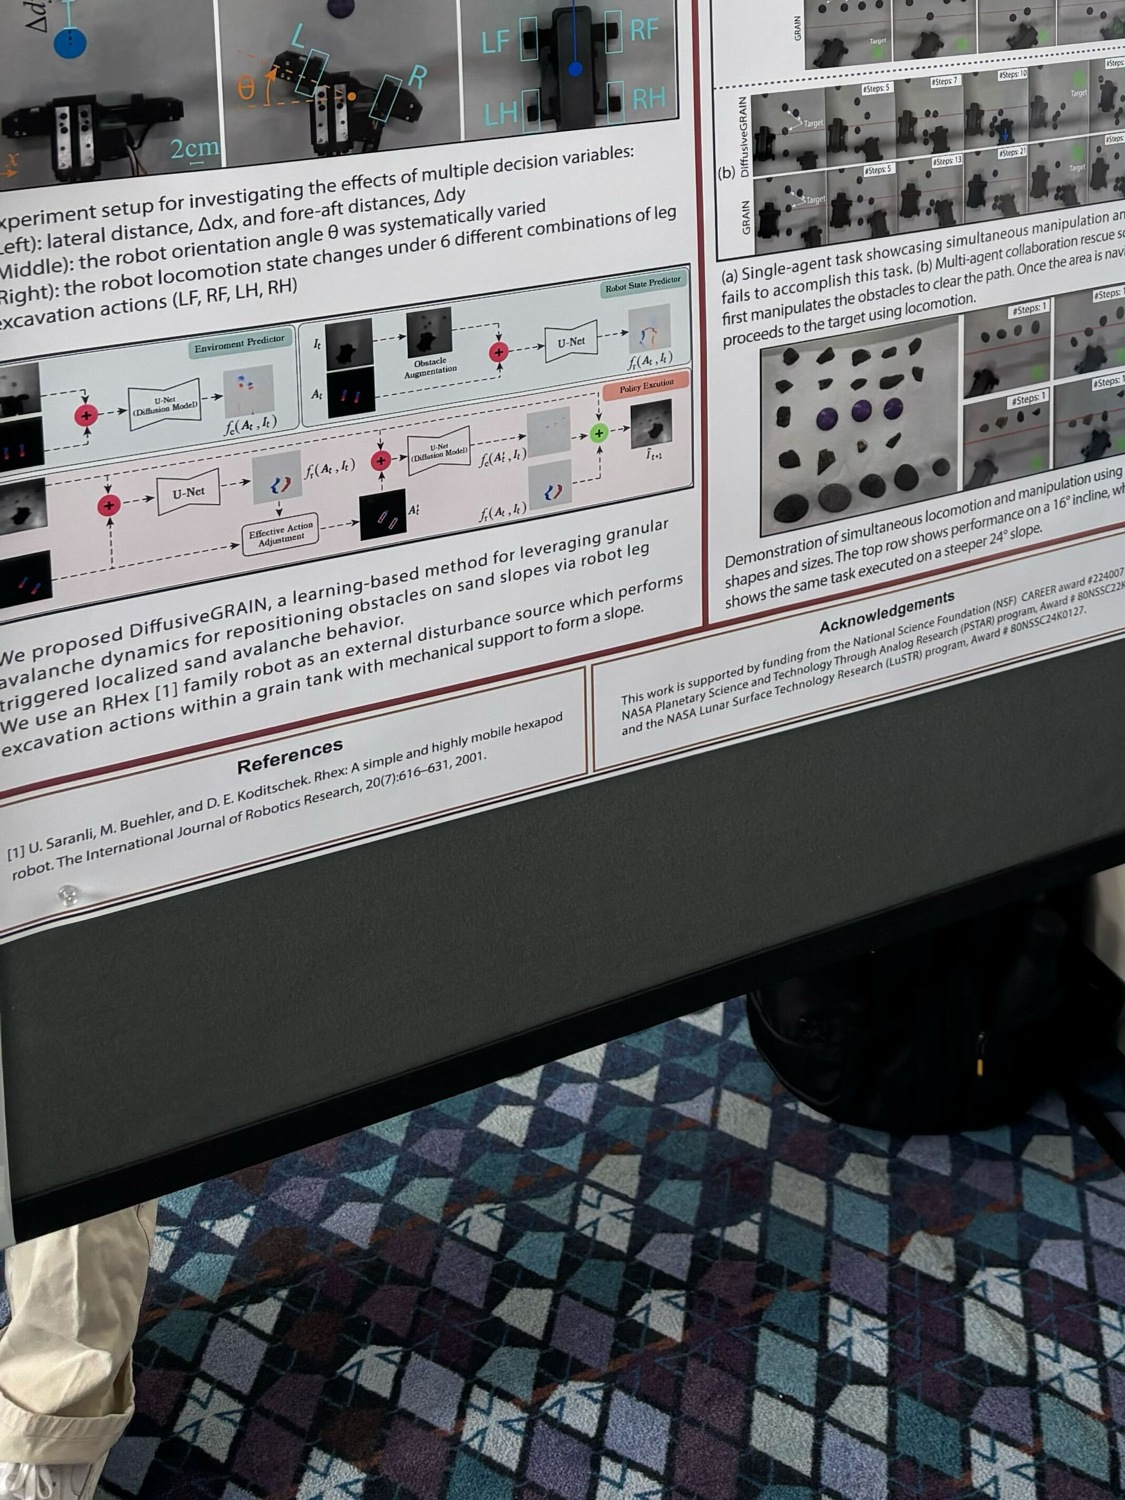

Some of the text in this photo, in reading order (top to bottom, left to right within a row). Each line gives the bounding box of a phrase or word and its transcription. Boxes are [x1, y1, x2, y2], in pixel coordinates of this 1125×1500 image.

[630, 18, 658, 41] RF
[482, 30, 509, 54] LF
[633, 88, 665, 110] RH
[485, 102, 517, 127] LH
[170, 137, 219, 161] 2cm
[606, 276, 681, 293] Robot State Predictor
[723, 292, 976, 349] proceeds to the target using locomotion.
[195, 334, 285, 353] Enviroment Predictor
[620, 378, 674, 395] Policy Excution
[819, 590, 955, 634] Acknowledgements
[0, 612, 404, 714] triggered localized sand avalanche behavior.
[622, 723, 643, 736] and
[646, 718, 664, 730] the
[667, 709, 697, 724] NASA
[700, 701, 729, 715] Lunar
[733, 689, 772, 707] Surface
[775, 674, 835, 696] Technology
[838, 661, 883, 679] Research
[886, 651, 923, 669] (LuSTR)
[925, 636, 969, 658] program,
[971, 628, 1000, 645] Award
[1003, 625, 1009, 635] #
[237, 739, 344, 774] References
[12, 861, 54, 881] robot.
[57, 855, 82, 868] The
[87, 829, 173, 861] International
[177, 817, 225, 839] Journal
[229, 812, 242, 824] of
[246, 798, 300, 820] Robotics
[304, 782, 362, 805] Research,
[456, 751, 486, 767] 2001.
